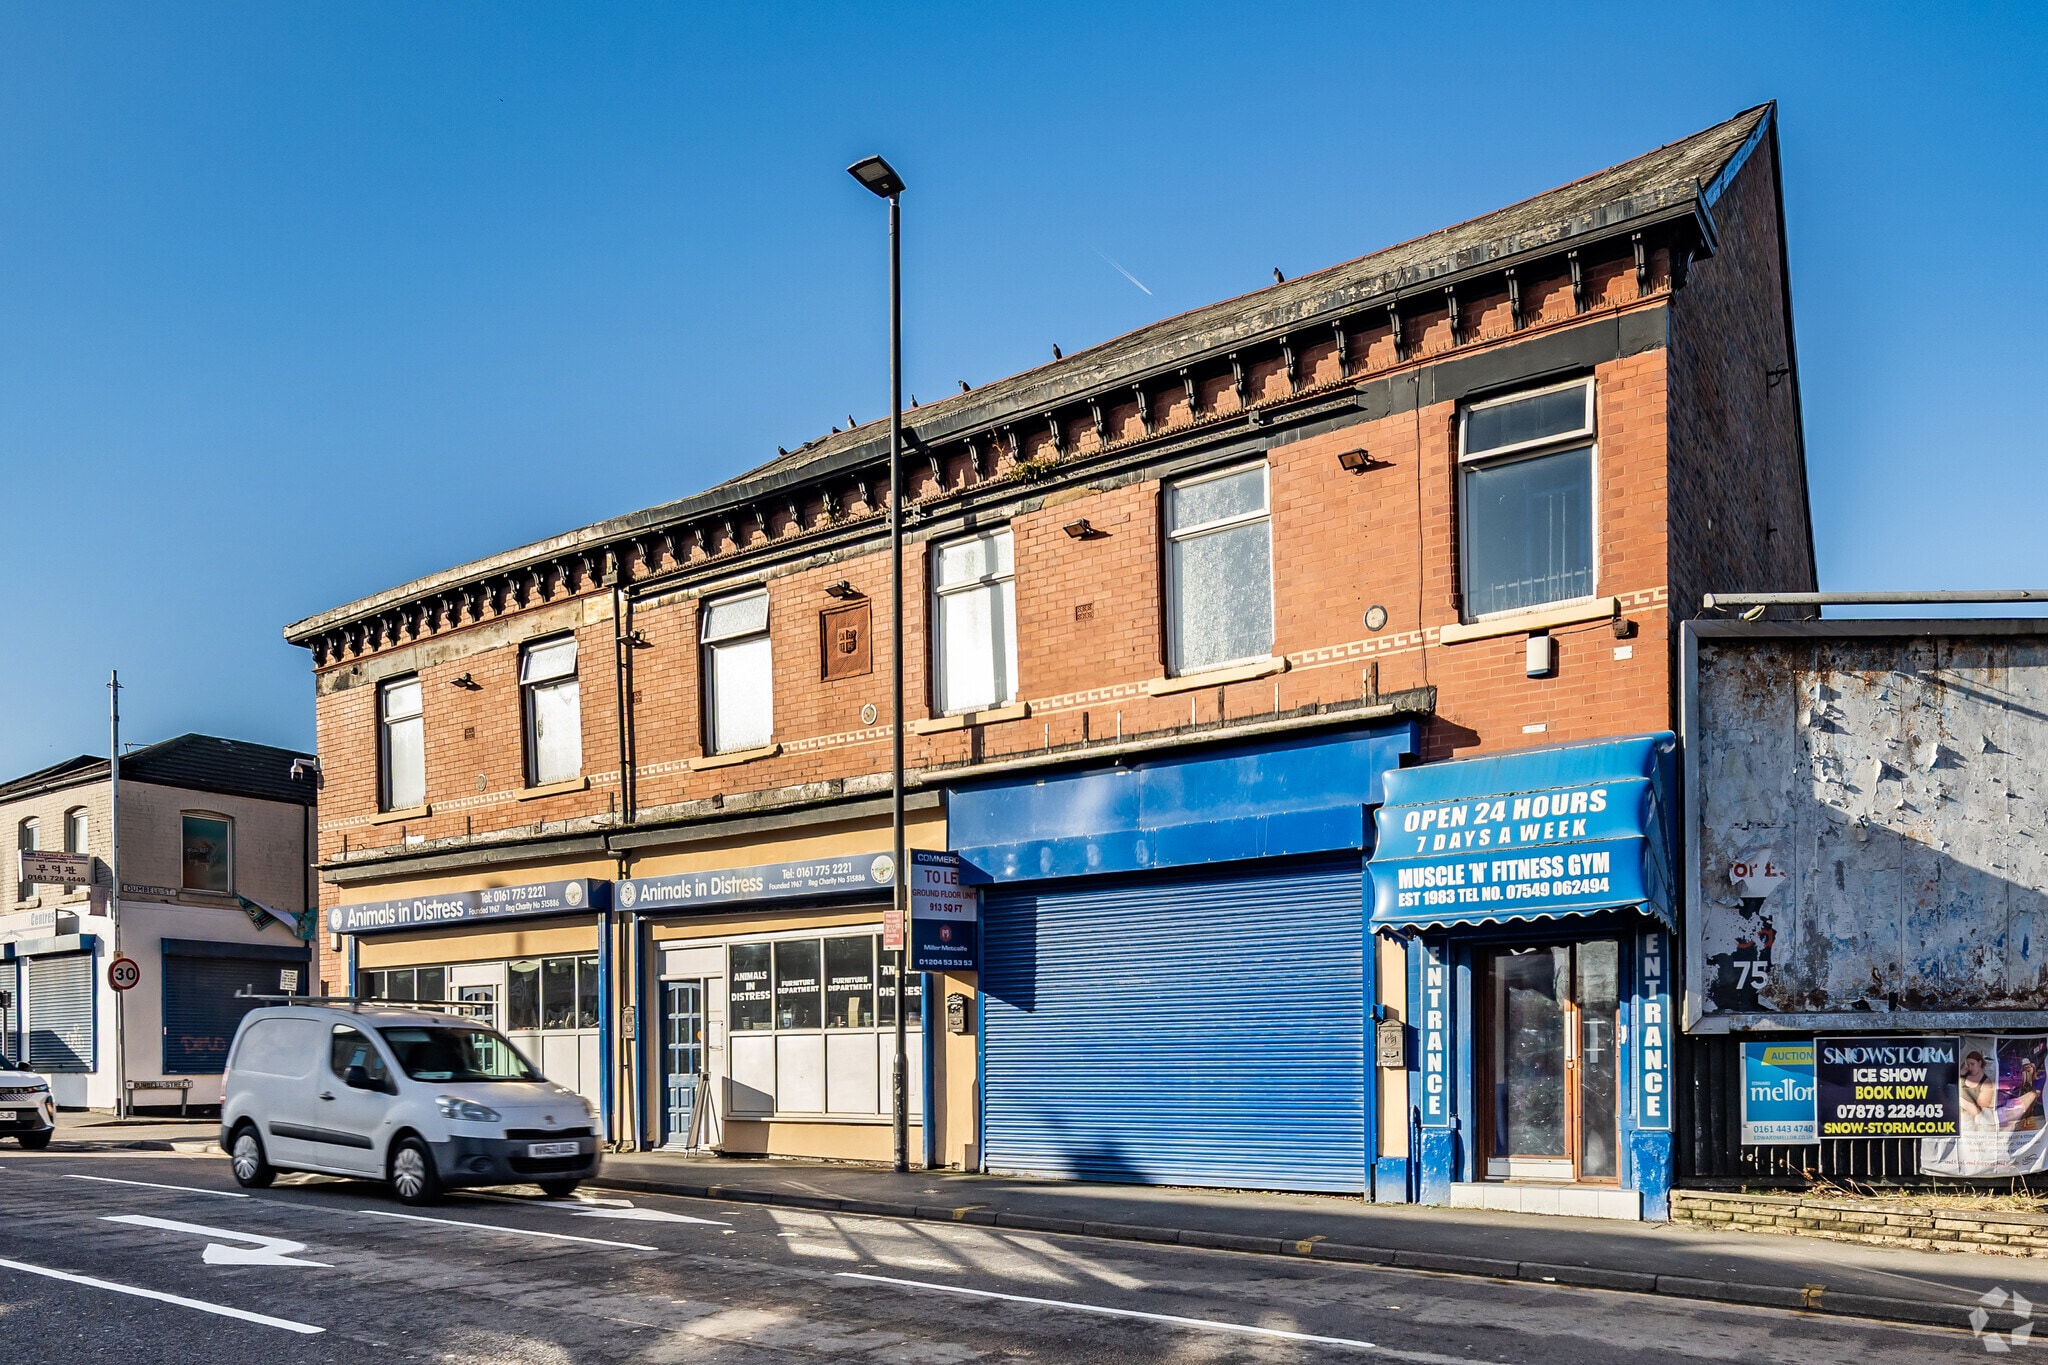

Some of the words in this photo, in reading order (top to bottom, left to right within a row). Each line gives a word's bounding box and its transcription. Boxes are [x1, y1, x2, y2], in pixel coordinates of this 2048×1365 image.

[1403, 805, 1467, 833] OPEN
[1473, 800, 1506, 825] 24
[1512, 789, 1608, 820] HOURS
[1416, 835, 1426, 853] 7
[1433, 827, 1491, 851] DAYS
[1498, 827, 1511, 844] A
[1520, 818, 1587, 841] WEEK
[782, 868, 795, 880] Tel:
[796, 867, 814, 878] 0161
[815, 865, 830, 876] 775
[832, 862, 852, 875] 2221
[924, 869, 941, 884] TO
[1397, 863, 1465, 890] MUSCLE
[1469, 862, 1488, 884] 'N'
[1491, 855, 1564, 882] FITNESS
[1568, 851, 1610, 877] GYM
[127, 885, 161, 894] DUMBELL
[640, 879, 691, 902] Animals
[695, 878, 707, 897] in
[711, 876, 763, 896] Distress
[768, 881, 790, 891] Founded
[790, 880, 803, 889] 1967
[808, 879, 818, 888] Reg
[819, 877, 837, 886] Charity
[837, 876, 846, 884] No
[480, 891, 493, 904] Tel:
[494, 889, 510, 902] 0161
[511, 887, 526, 900] 775
[528, 885, 547, 899] 2221
[912, 888, 940, 898] GROUND
[941, 890, 961, 899] FLOOR
[962, 892, 977, 900] UNIT
[1398, 891, 1421, 907] EST
[1422, 888, 1455, 905] 1983
[1458, 887, 1480, 902] TEL
[1482, 885, 1503, 901] NO.
[1506, 882, 1550, 899] 07549
[1553, 877, 1610, 896] 062494
[347, 902, 396, 928] Animals
[398, 901, 411, 923] in
[413, 899, 464, 922] Distress
[468, 906, 488, 916] Founded
[489, 904, 500, 914] 1967
[505, 904, 515, 913] Reg
[515, 901, 533, 911] Charity
[929, 902, 942, 912] 913
[943, 903, 953, 913] SQ
[954, 904, 963, 913] FT
[31, 912, 55, 926] Centres
[919, 958, 942, 966] 01204
[115, 967, 136, 981] 30
[734, 971, 768, 981] ANIMALS
[832, 976, 868, 985] FURNITURE
[1733, 961, 1768, 990] 75
[745, 982, 756, 991] IN
[777, 985, 820, 994] DEPARTMENT
[781, 979, 815, 987] FURNITURE
[827, 983, 873, 992] DEPARTMENT
[731, 990, 771, 1002] DISTRESS
[1426, 945, 1443, 1115] ENTRANCE
[1643, 933, 1663, 1117] ENTRANCE
[1771, 1051, 1813, 1061] AUCTION
[1823, 1046, 1956, 1065] SNOWSTORM
[1853, 1068, 1877, 1083] ICE
[1880, 1068, 1927, 1082] SHOW
[165, 1080, 192, 1089] STREET
[1750, 1078, 1814, 1102] mellor
[1855, 1086, 1894, 1100] BOOK
[1896, 1086, 1928, 1100] NOW
[1837, 1104, 1885, 1119] 07878
[1888, 1104, 1944, 1118] 228403
[1753, 1125, 1773, 1133] 0161
[1776, 1125, 1792, 1133] 443
[1793, 1124, 1814, 1133] 4740
[1823, 1122, 1956, 1134] SNOW-STORM.CO.UK
